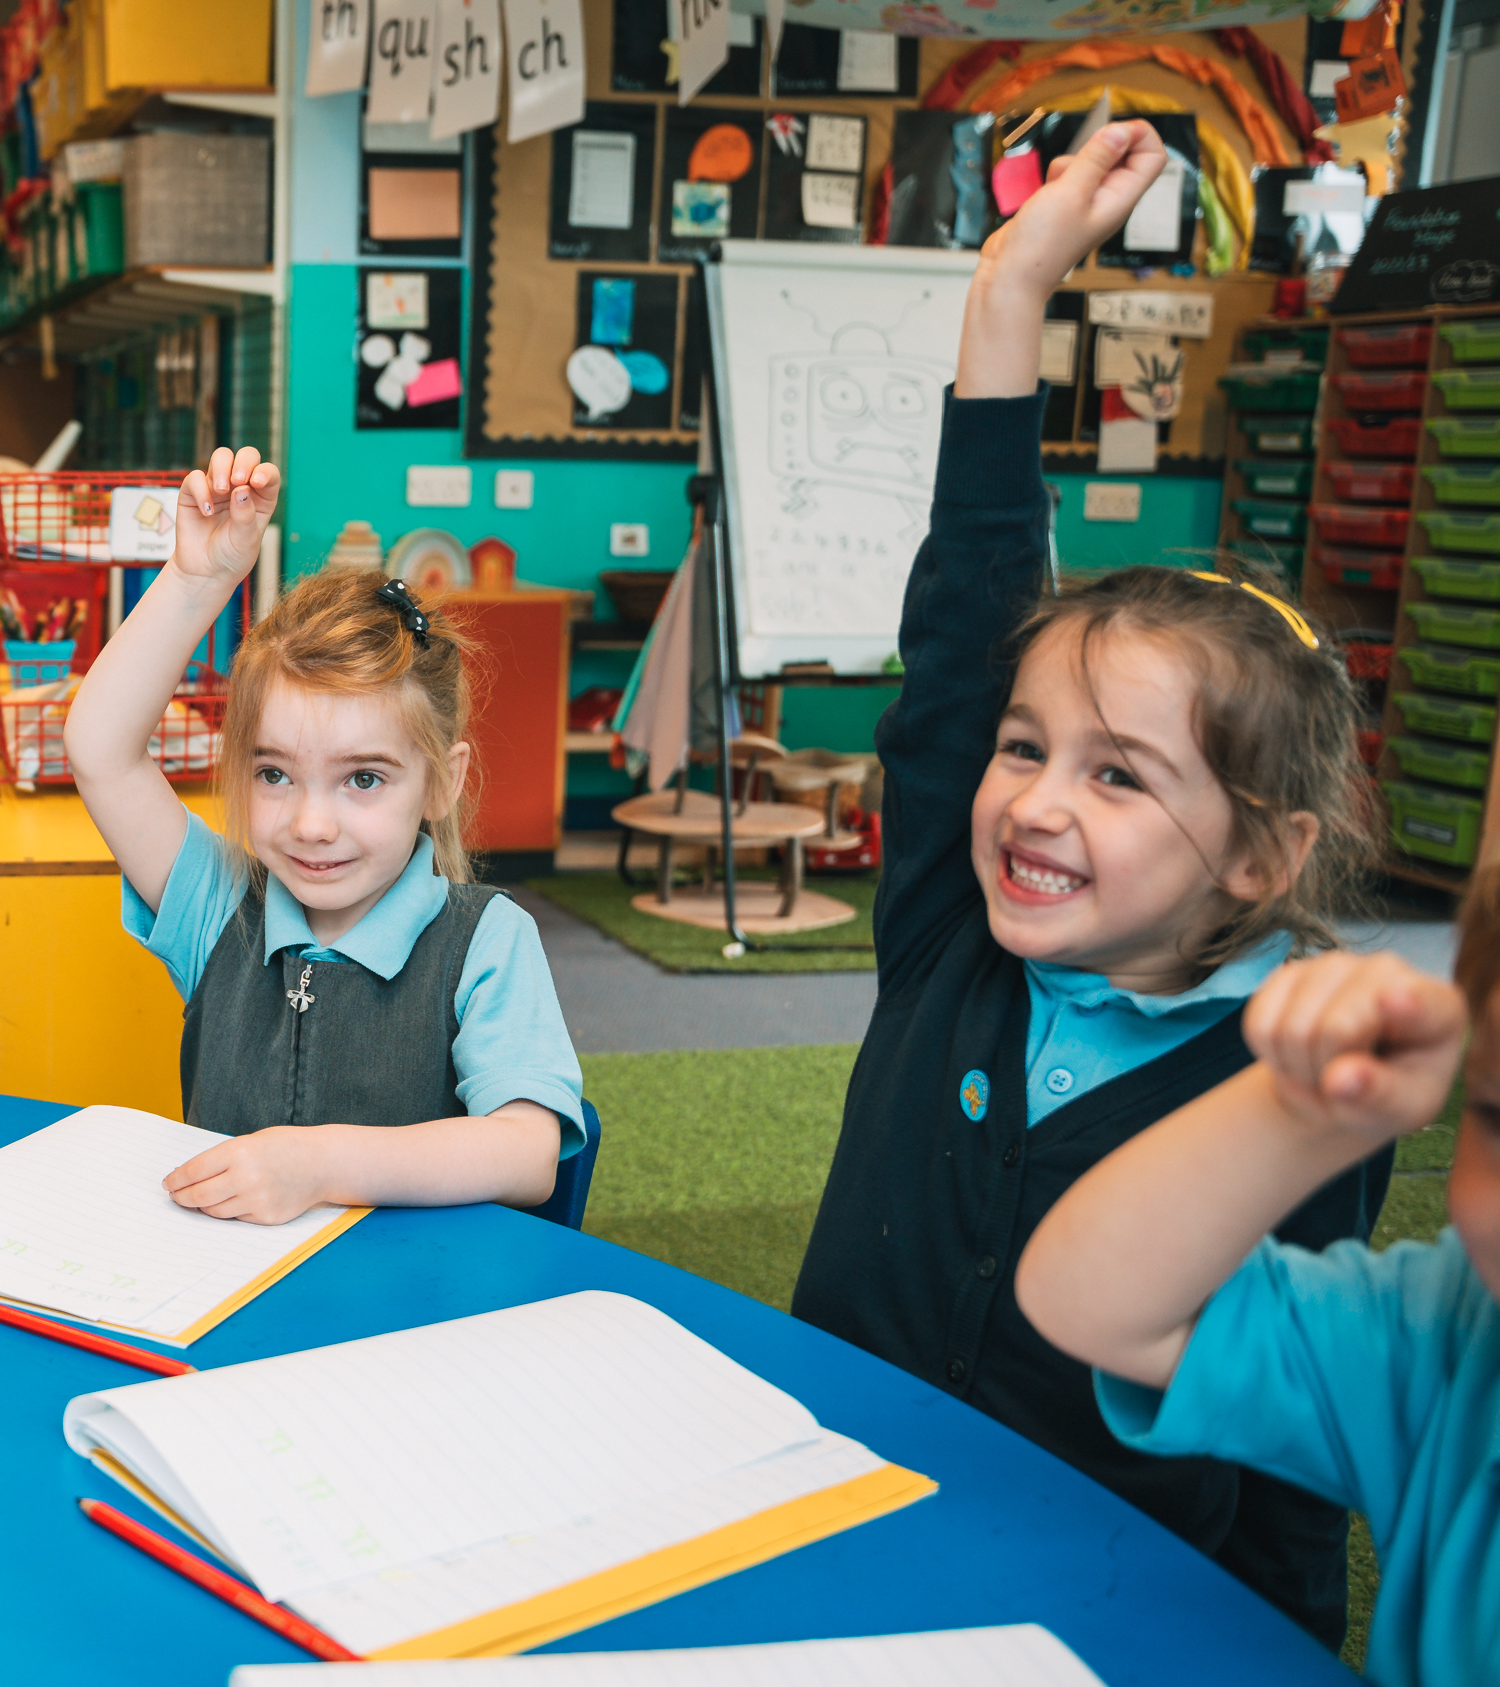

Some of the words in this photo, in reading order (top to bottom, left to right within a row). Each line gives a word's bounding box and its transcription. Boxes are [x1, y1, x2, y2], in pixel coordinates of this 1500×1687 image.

[378, 17, 429, 78] qu
[442, 17, 490, 87] sh
[517, 16, 568, 80] ch
[1383, 206, 1462, 232] Foundation
[137, 542, 168, 552] paper
